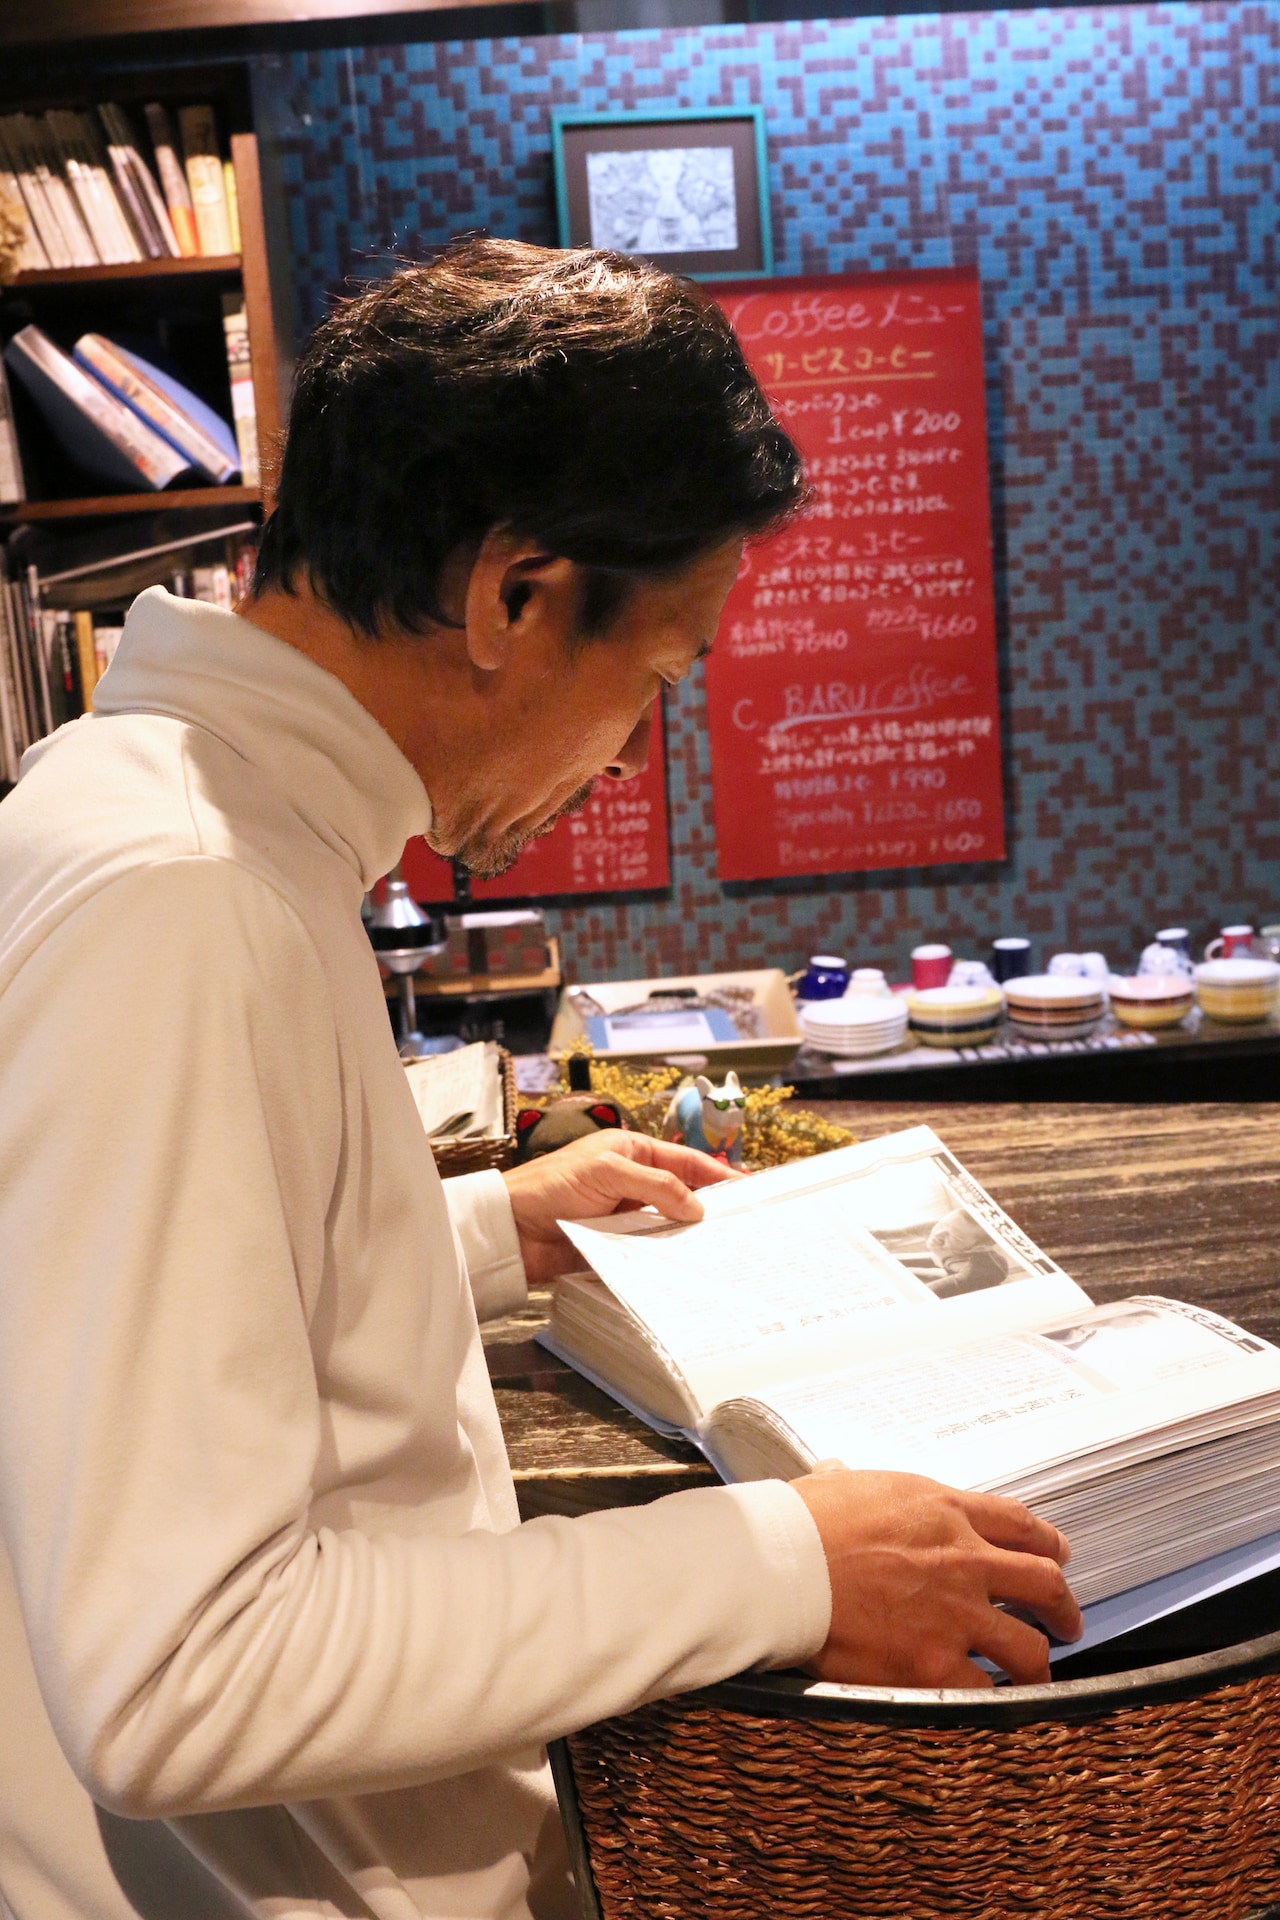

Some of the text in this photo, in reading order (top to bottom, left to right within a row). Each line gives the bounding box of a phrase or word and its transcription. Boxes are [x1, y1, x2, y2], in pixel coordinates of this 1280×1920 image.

[732, 292, 964, 341] Coffee メニュー
